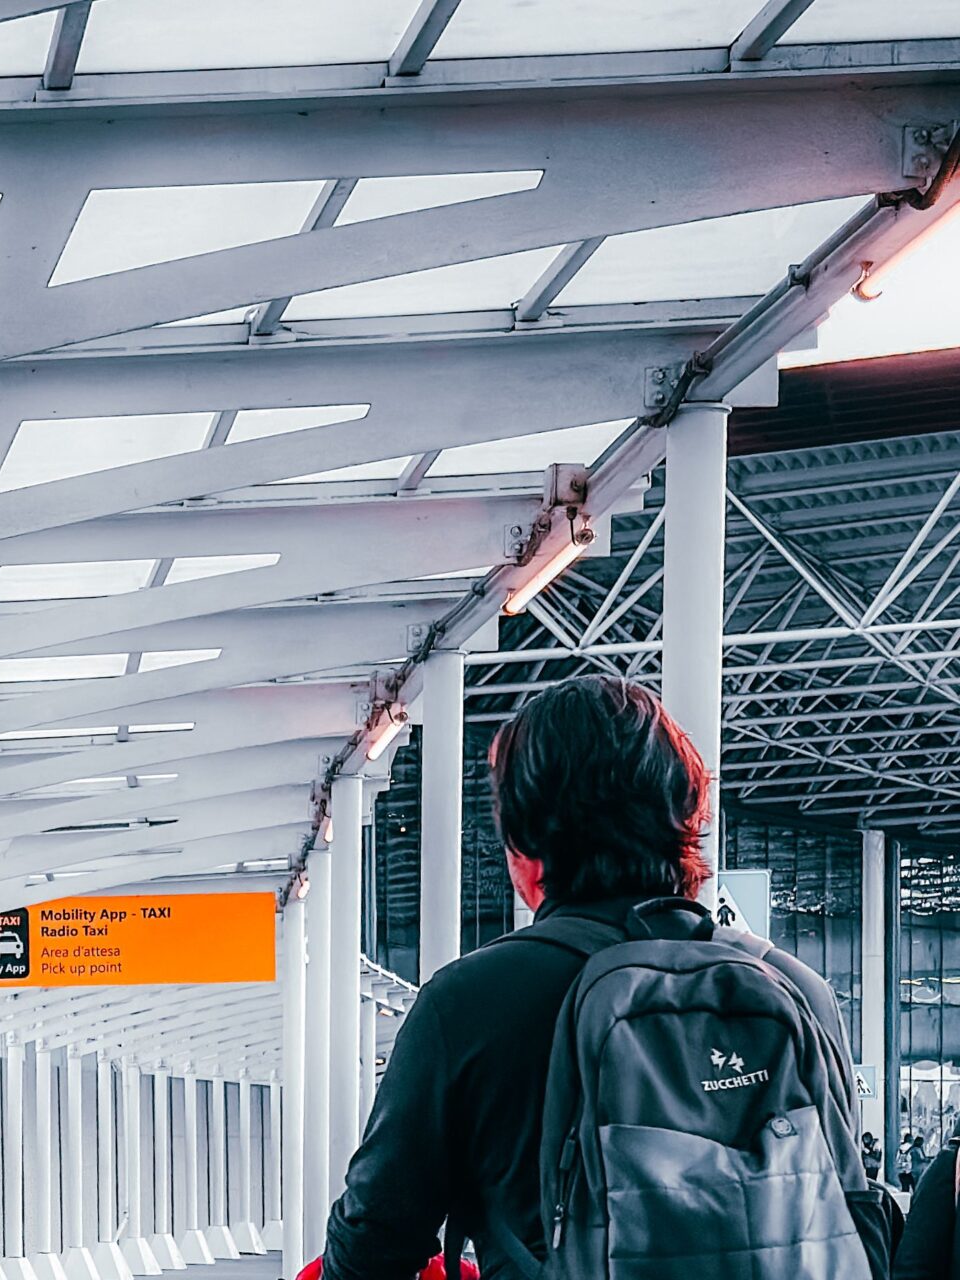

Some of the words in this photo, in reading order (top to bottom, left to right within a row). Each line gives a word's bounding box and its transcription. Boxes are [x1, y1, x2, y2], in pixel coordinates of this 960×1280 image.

[41, 909, 96, 923] Mobility
[100, 909, 127, 922] App
[141, 907, 171, 918] TAXI
[41, 926, 78, 937] Radio
[83, 925, 108, 936] Taxi
[41, 947, 69, 958] Area
[73, 946, 121, 957] d'attesa
[5, 963, 26, 975] App
[41, 962, 66, 974] Pick
[70, 965, 86, 976] up
[90, 962, 122, 976] point
[701, 1069, 769, 1091] ZUCCHETTI
